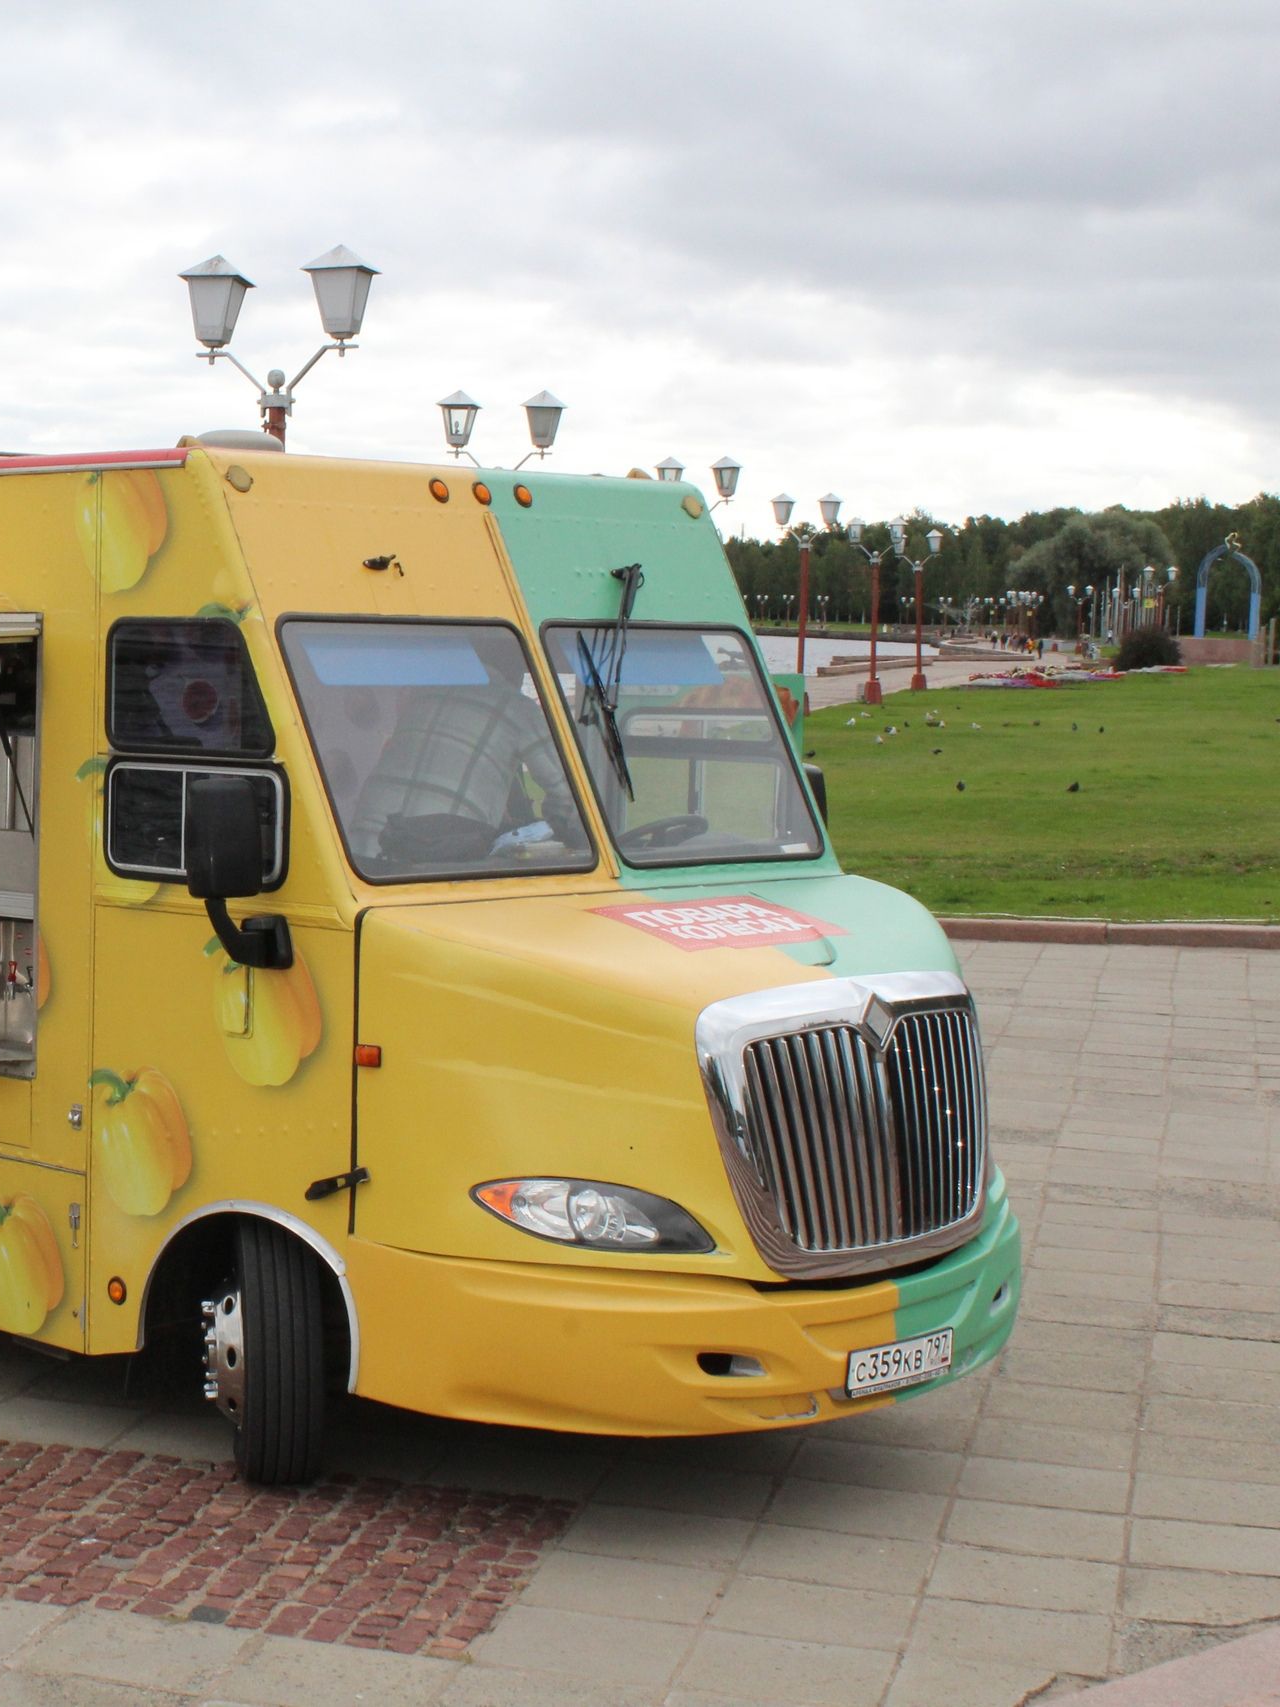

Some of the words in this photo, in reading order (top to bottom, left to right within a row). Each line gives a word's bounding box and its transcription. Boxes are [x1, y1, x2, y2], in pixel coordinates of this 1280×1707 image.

[624, 903, 782, 927] ПОВАРА
[661, 917, 814, 940] КОЛЕСАХ
[926, 1334, 948, 1360] 797
